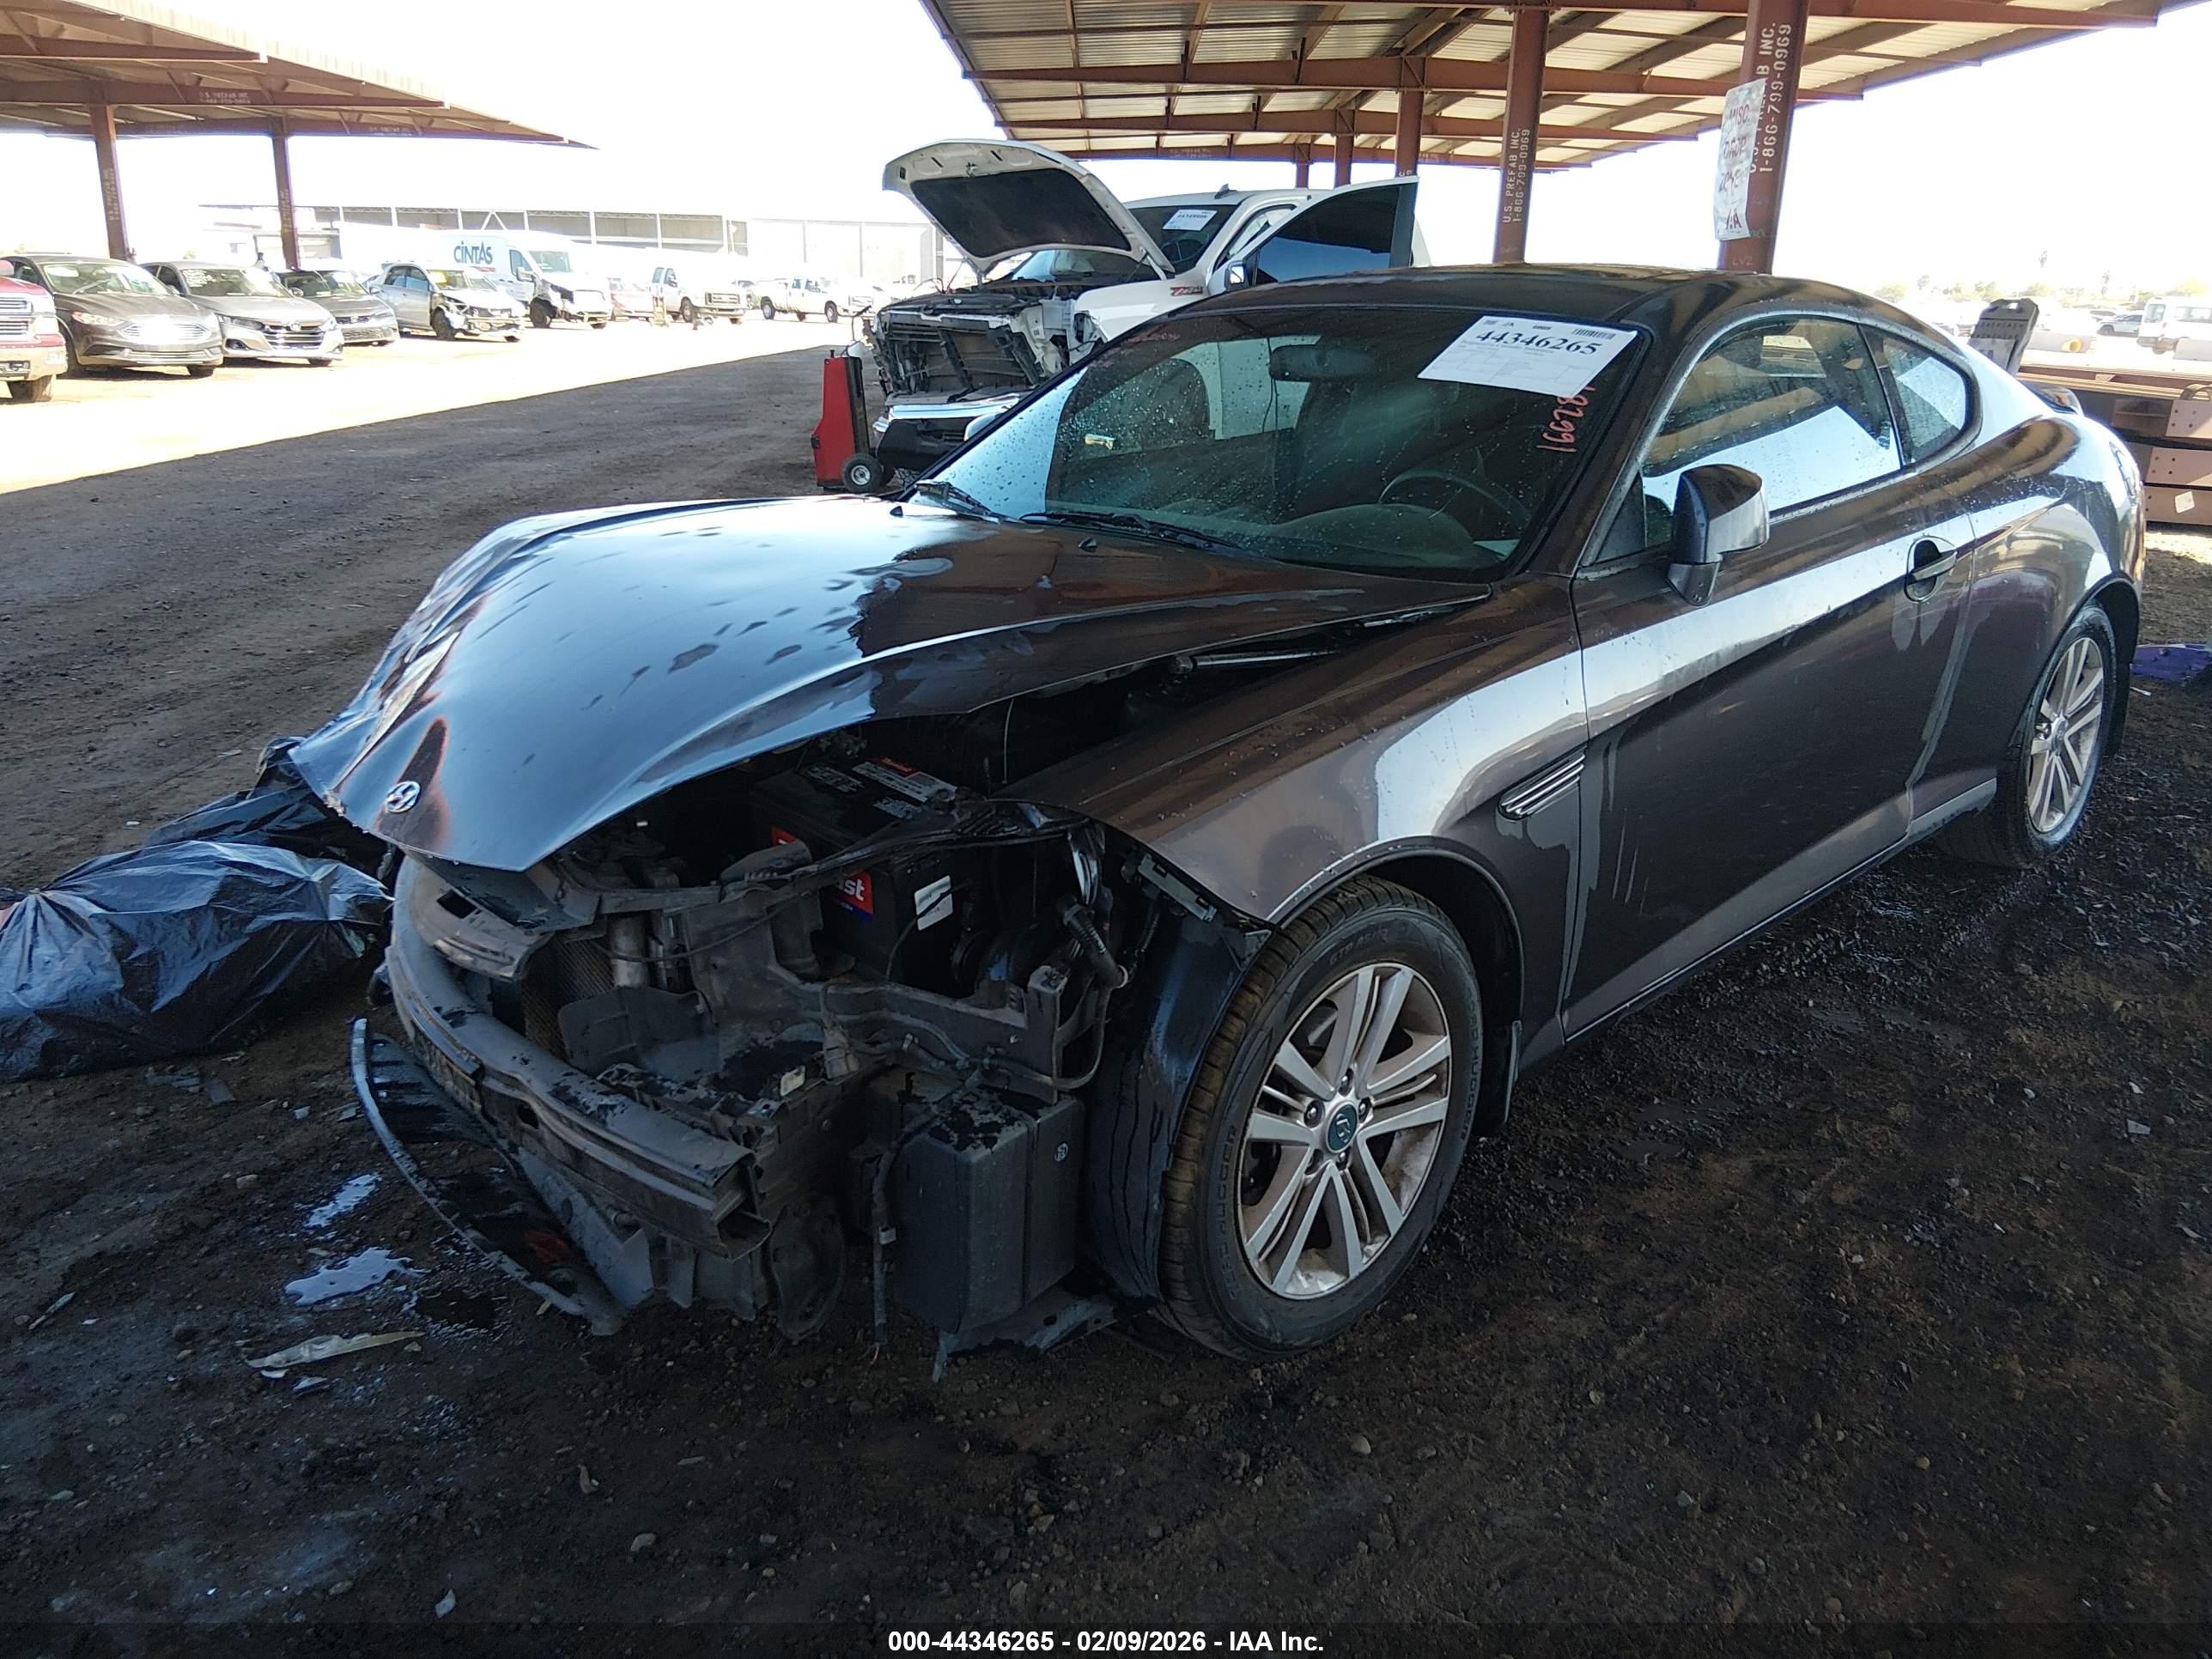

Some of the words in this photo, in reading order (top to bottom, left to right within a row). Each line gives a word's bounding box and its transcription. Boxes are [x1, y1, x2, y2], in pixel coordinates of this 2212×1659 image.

[1759, 21, 1777, 56] INC.
[1759, 23, 1792, 173] 1-866-799-0969
[1510, 127, 1522, 149] INC.
[1505, 153, 1518, 197] PREFAB
[1512, 128, 1531, 222] 1-866-799-0969
[1503, 203, 1514, 223] U.S.
[453, 240, 494, 265] CINTAS
[1475, 330, 1602, 356] 44346265
